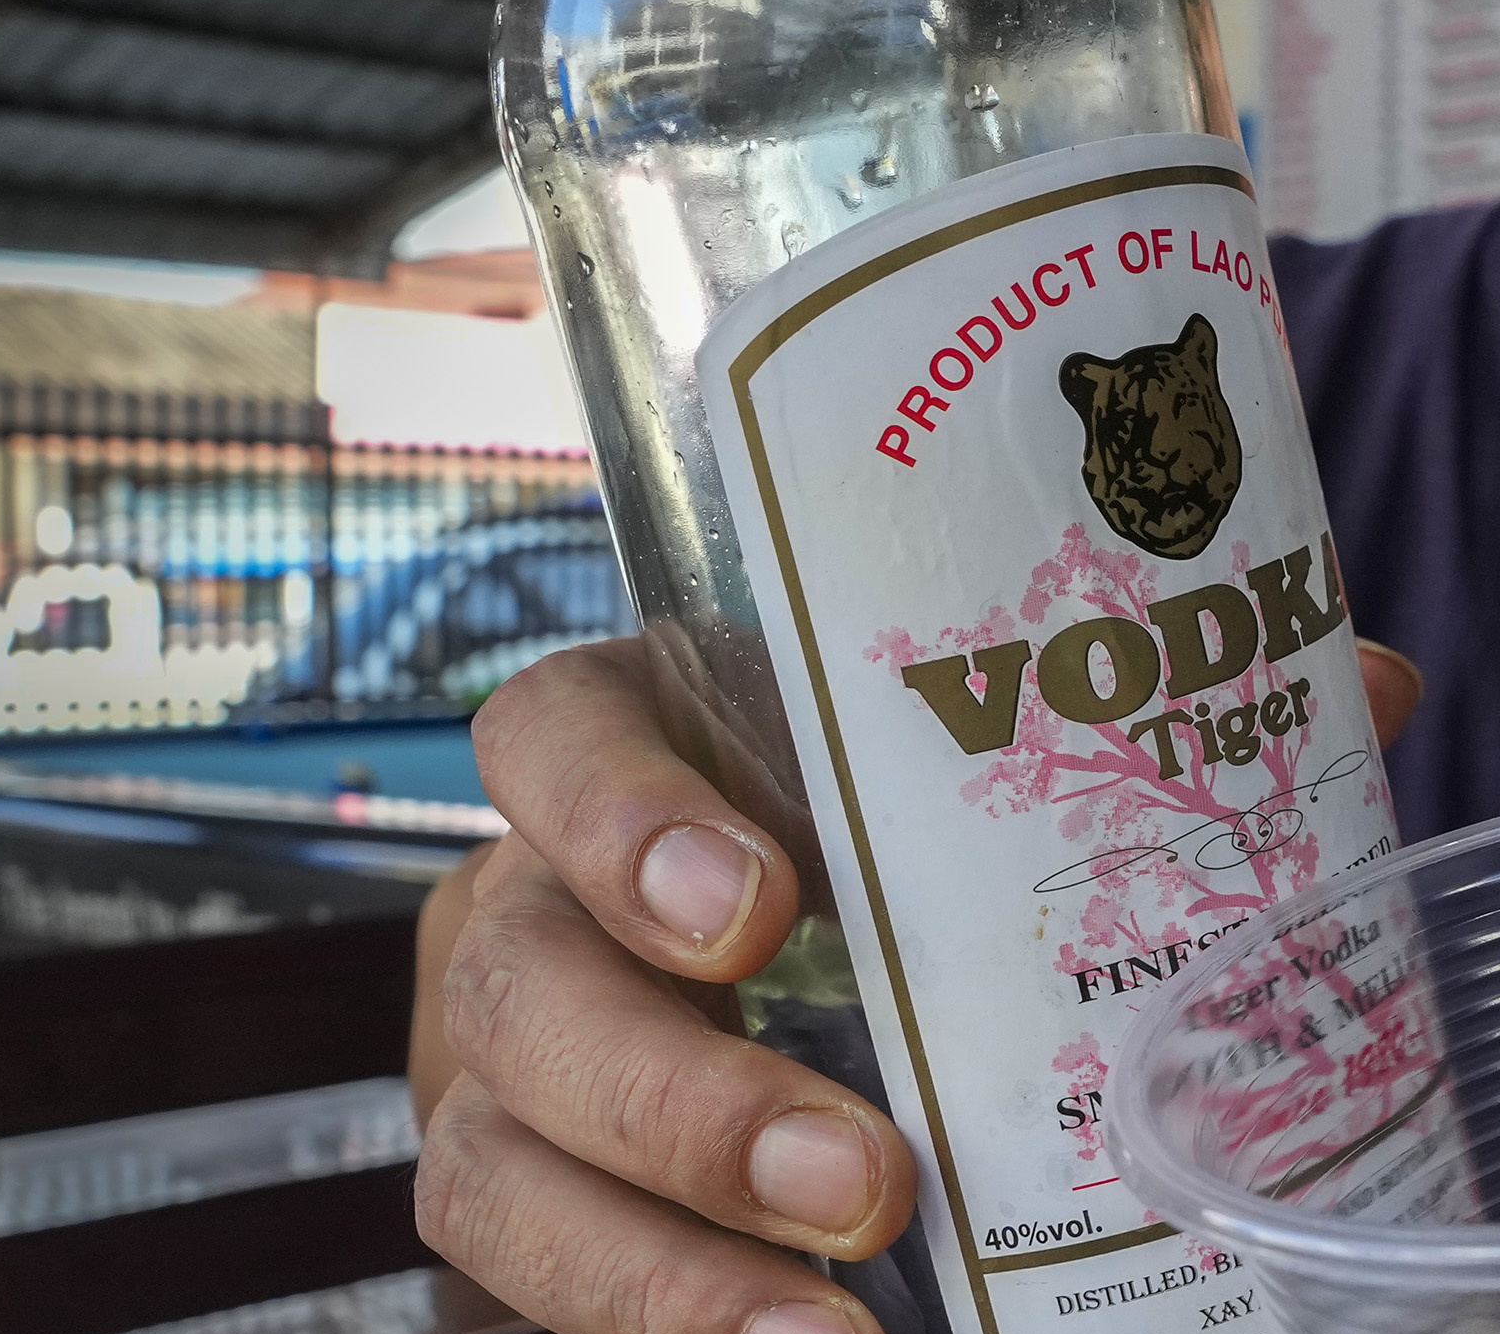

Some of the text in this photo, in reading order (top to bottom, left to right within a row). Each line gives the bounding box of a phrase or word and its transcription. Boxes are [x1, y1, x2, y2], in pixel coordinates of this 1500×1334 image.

[876, 228, 1292, 467] PRODUCT OF LAO PD
[1127, 676, 1312, 782] Tiger
[1290, 919, 1382, 983] Vodka
[985, 1210, 1103, 1251] 40%vol.
[1056, 1264, 1206, 1316] DISTILLED,
